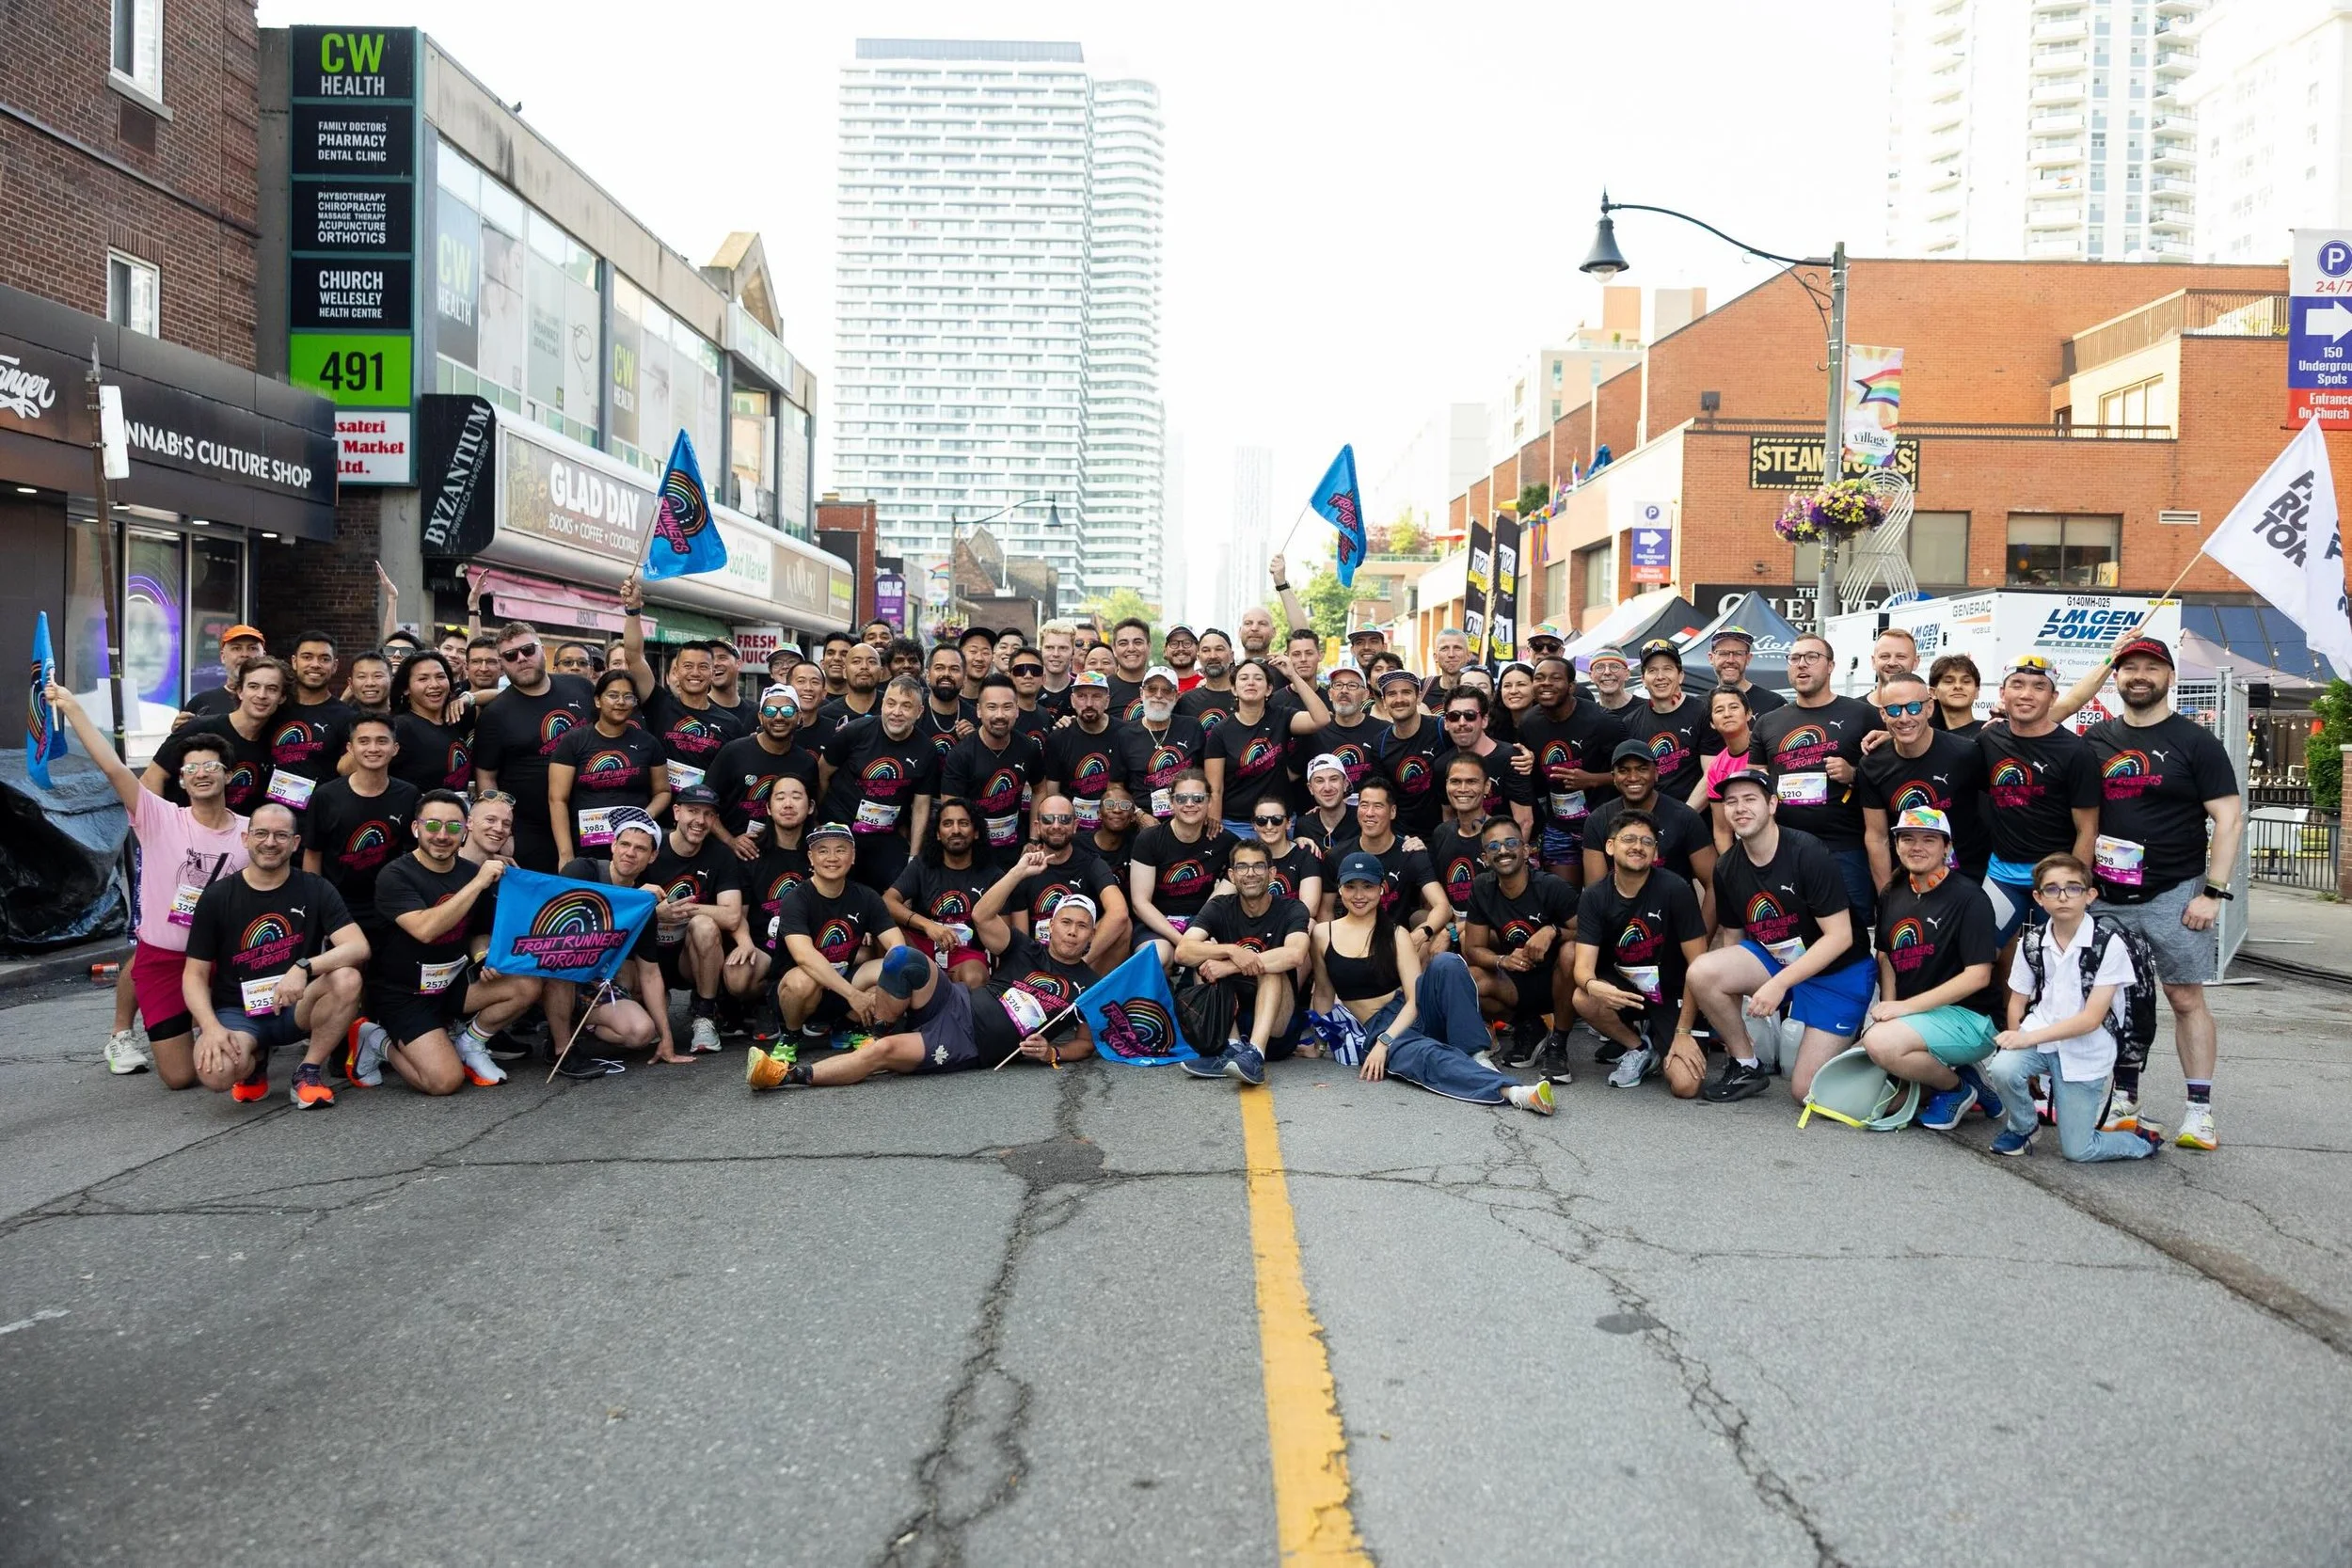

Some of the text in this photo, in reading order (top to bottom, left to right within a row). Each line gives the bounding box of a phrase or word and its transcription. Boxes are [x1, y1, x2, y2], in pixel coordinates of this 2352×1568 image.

[321, 33, 385, 73] CW
[321, 75, 385, 96] HEALTH
[318, 121, 387, 132] FAMILY DOCTORS
[318, 134, 387, 147] PHARMACY
[318, 150, 387, 162] DENTAL CLINIC
[318, 192, 386, 201] PHYSIOTHERAPY
[318, 201, 386, 213] CHIROPRACTIC
[318, 212, 386, 221] MASSAGE THERAPY
[318, 220, 386, 231] ACUPUNCTURE
[318, 231, 386, 244] ORTHOTICS
[437, 232, 471, 295] CW
[319, 270, 384, 290] CHURCH
[320, 292, 382, 306] WELLESLEY
[437, 286, 471, 327] HEALTH
[319, 308, 383, 319] HEALTH CENTRE
[2323, 346, 2344, 358] 150
[319, 352, 384, 391] 491
[613, 343, 635, 390] CW
[2317, 373, 2348, 385] Spots
[334, 420, 386, 433] sateri
[343, 439, 405, 454] Market
[198, 440, 270, 480] CULTURE
[272, 459, 312, 489] SHOP
[424, 403, 491, 547] BYZANTIUM
[1795, 475, 1825, 484] ENTRA
[550, 461, 641, 531] GLAD DAY
[548, 512, 641, 555] BOOKS COFFEE COCKTAILS
[2067, 595, 2111, 608] G140MH-025
[1952, 600, 1992, 617] GENERAC
[2047, 609, 2145, 626] LM GEN
[1923, 623, 1940, 637] GEN
[737, 635, 777, 648] FRESH
[270, 786, 287, 797] 3217
[1781, 791, 1803, 800] 3210
[858, 815, 880, 825] 3245
[583, 824, 605, 834] 3982
[514, 930, 627, 955] FRONT RUNNERS
[539, 949, 600, 968] TORONTO
[426, 978, 450, 989] 2573
[1006, 993, 1021, 1012] 3216
